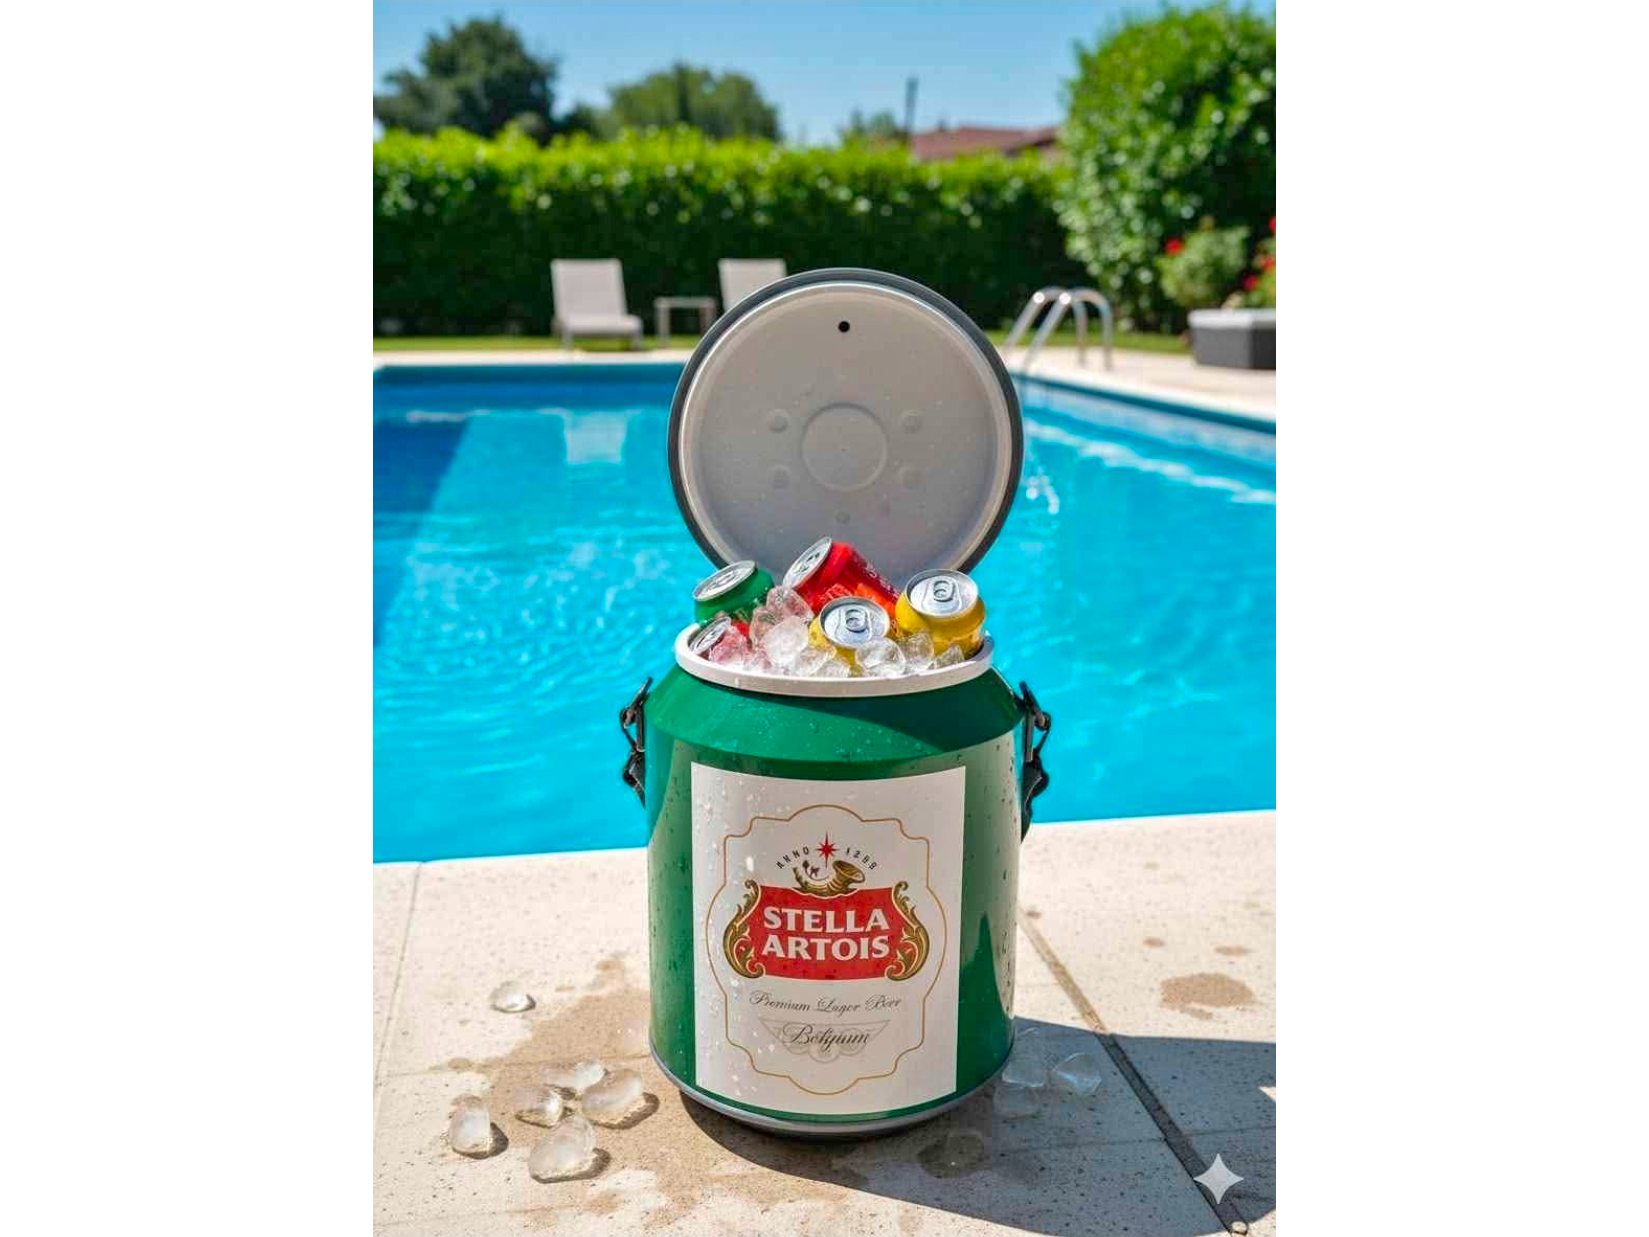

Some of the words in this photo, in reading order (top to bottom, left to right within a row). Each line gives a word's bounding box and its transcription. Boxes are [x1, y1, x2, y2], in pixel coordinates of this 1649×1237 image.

[776, 846, 810, 869] ANNO
[763, 906, 890, 933] STELLA
[761, 934, 890, 961] ARTOIS
[750, 990, 811, 1012] Premium
[814, 997, 861, 1018] Lager
